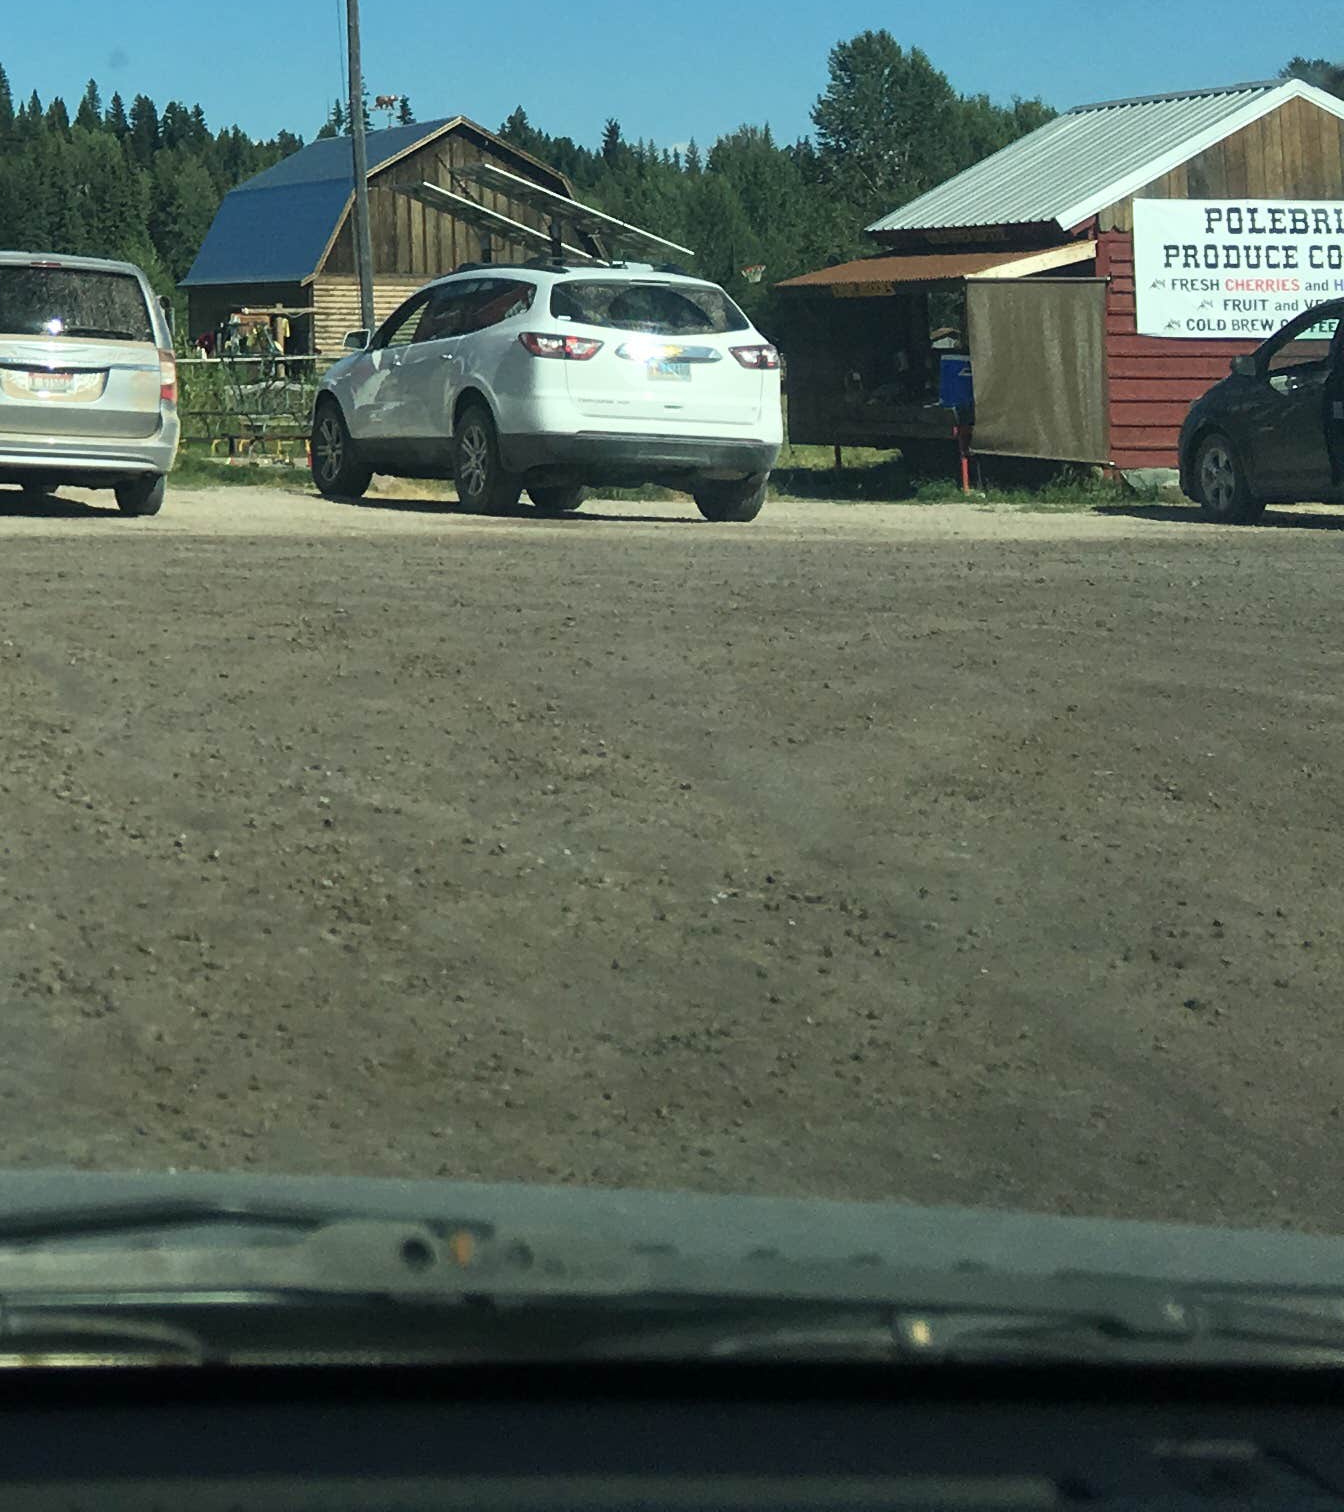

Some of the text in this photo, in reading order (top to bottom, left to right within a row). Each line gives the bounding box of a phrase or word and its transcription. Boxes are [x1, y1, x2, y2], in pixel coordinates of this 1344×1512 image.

[1163, 244, 1299, 270] PRODUCE
[1171, 278, 1220, 292] FRESH
[1224, 278, 1301, 293] CHERRIES
[1305, 278, 1329, 291] and
[1223, 298, 1269, 313] FRUIT
[1274, 299, 1299, 312] and
[1186, 318, 1227, 332] COLD
[1231, 318, 1275, 333] BREW
